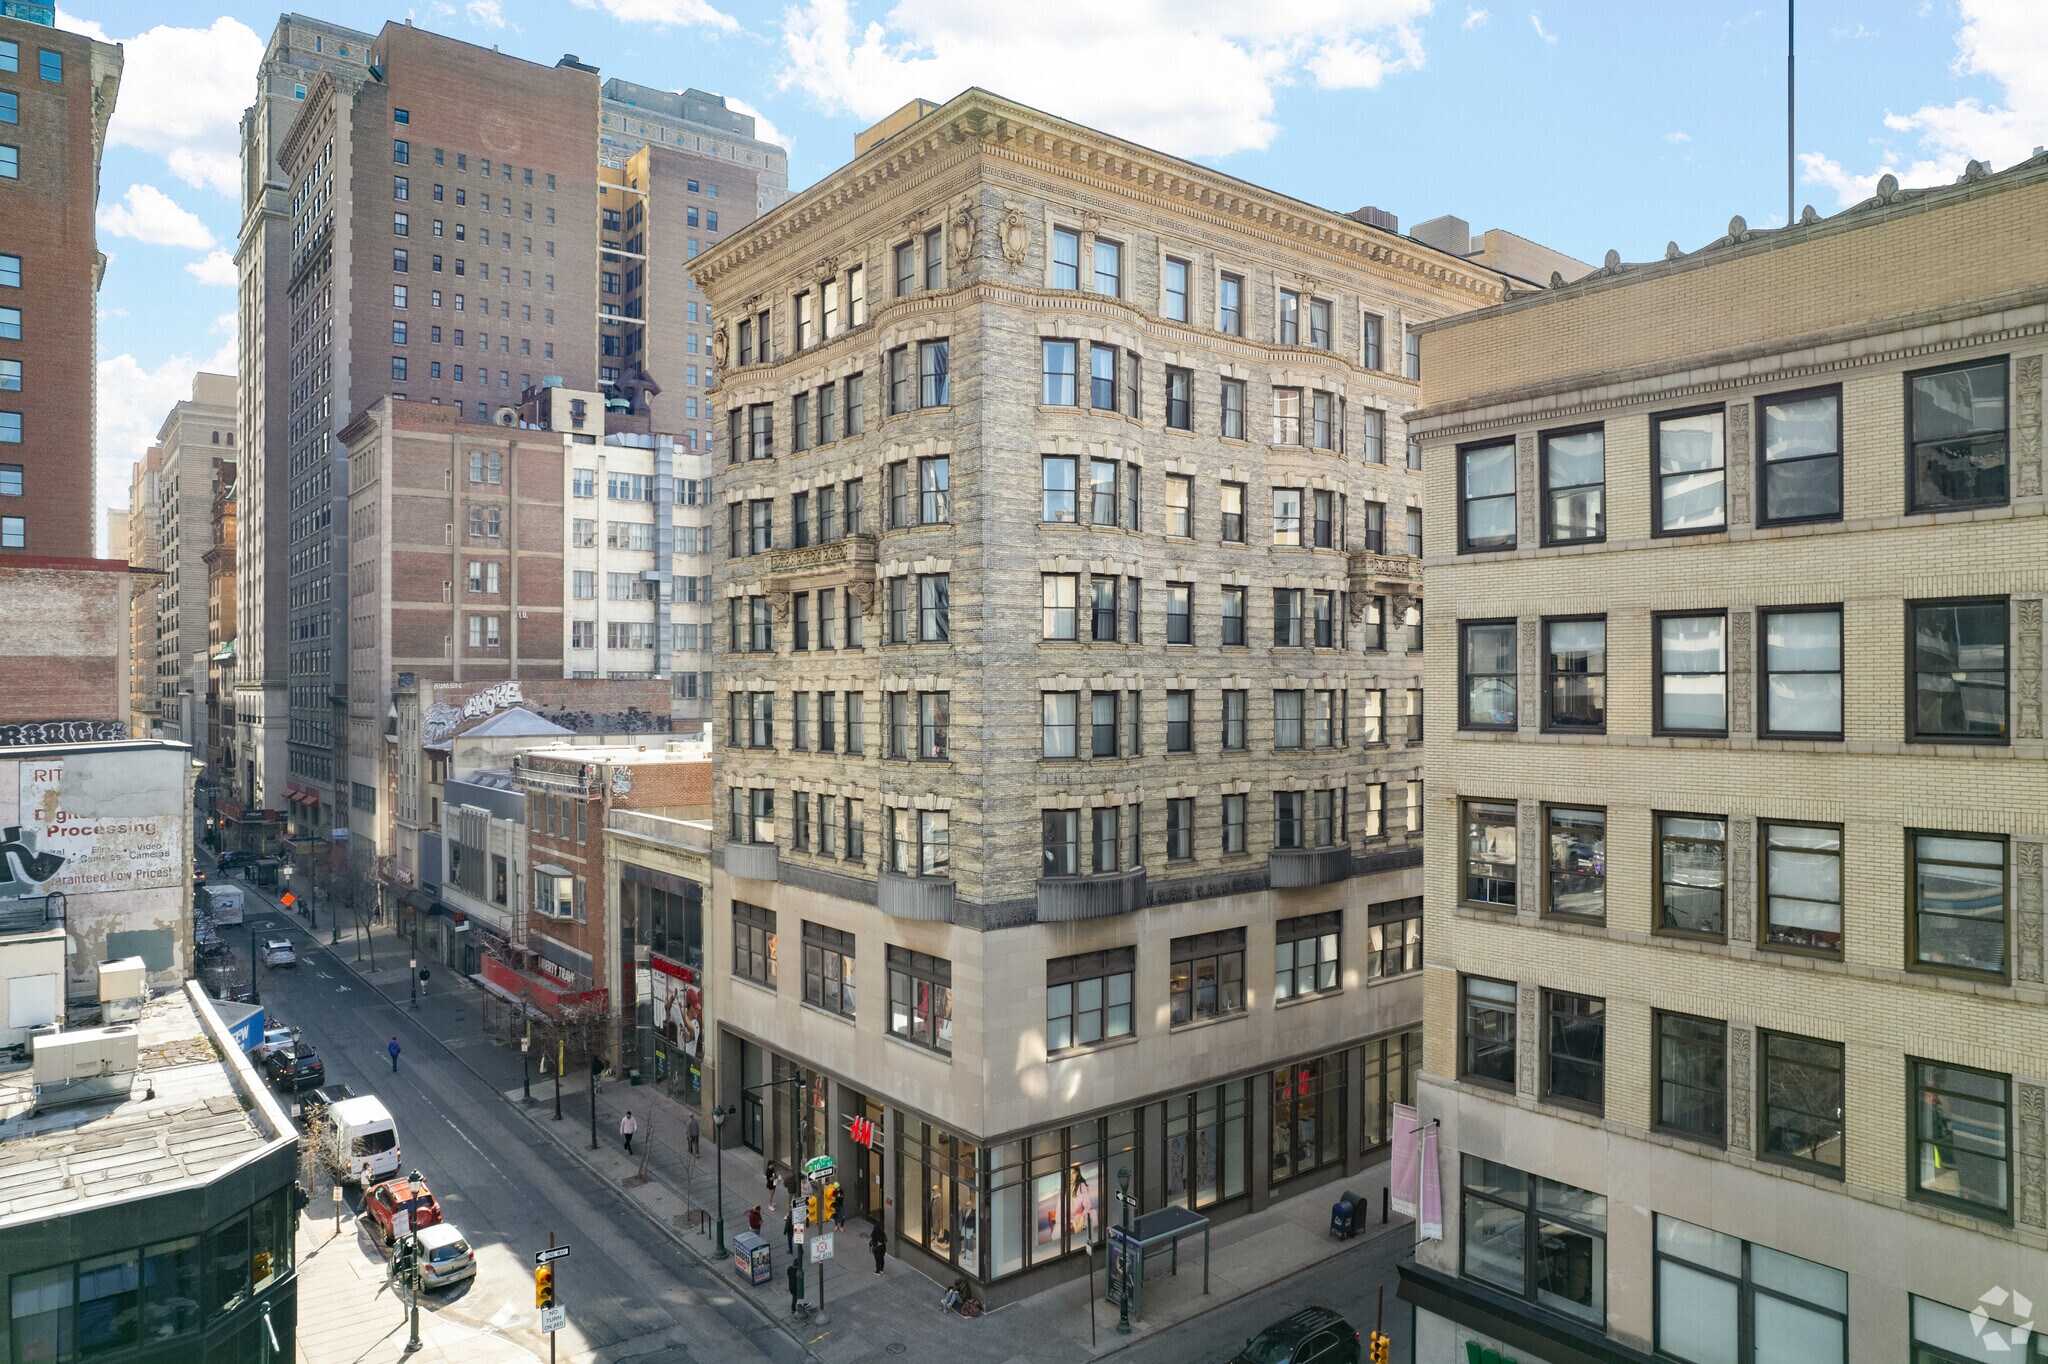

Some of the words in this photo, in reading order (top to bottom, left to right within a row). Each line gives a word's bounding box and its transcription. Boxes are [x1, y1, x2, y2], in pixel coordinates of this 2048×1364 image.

[47, 823, 156, 837] Processing
[137, 842, 163, 851] Video
[136, 867, 173, 880] Prices!
[850, 1115, 874, 1150] H&M
[556, 1248, 567, 1256] WAY
[546, 1315, 562, 1324] TURN
[553, 1321, 563, 1329] RED
